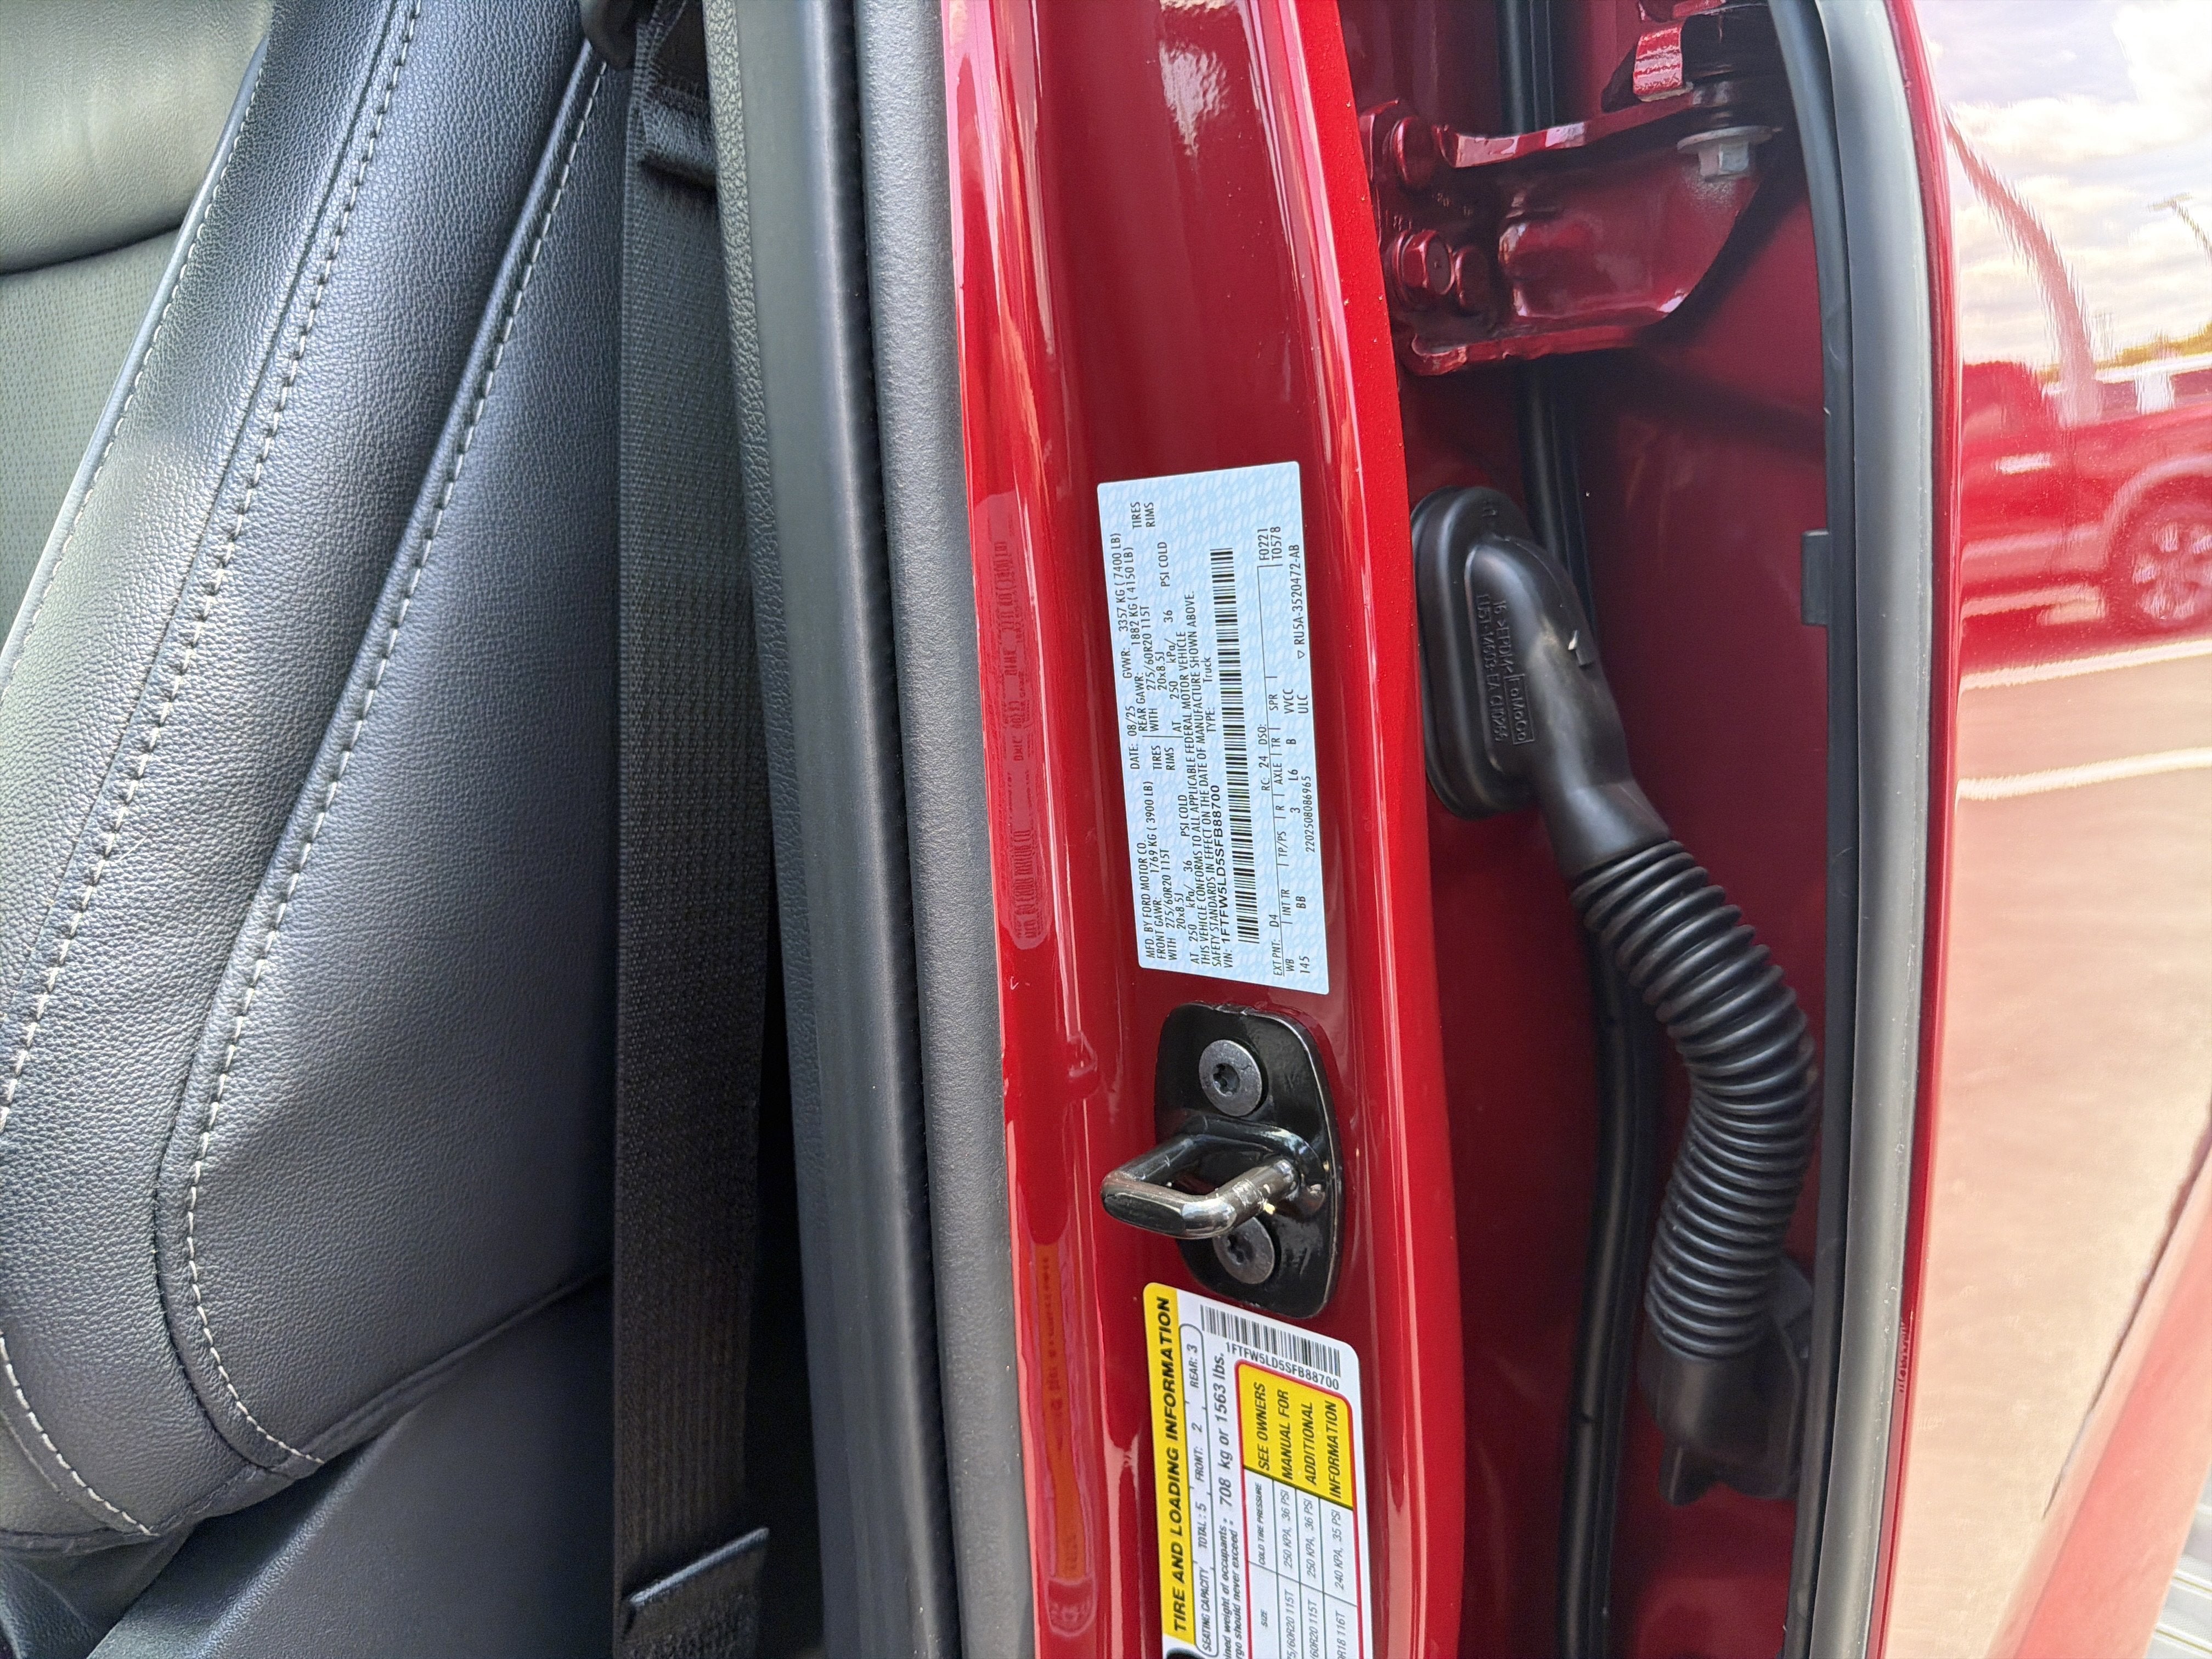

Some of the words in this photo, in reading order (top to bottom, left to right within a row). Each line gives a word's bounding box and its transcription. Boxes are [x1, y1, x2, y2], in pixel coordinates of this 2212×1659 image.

[1130, 501, 1142, 530] TIRES
[1143, 502, 1156, 528] RIMS
[1109, 533, 1121, 549] LB)
[1257, 528, 1270, 561] F0221
[1269, 526, 1283, 561] T0578
[1111, 552, 1124, 579] 7400
[1122, 547, 1134, 563] LB)
[1157, 541, 1169, 568] COLD
[1124, 567, 1136, 593] 4150
[1159, 572, 1171, 587] PSI
[1115, 589, 1126, 603] KG
[1288, 544, 1305, 645] RU5A-3520472-AB
[1116, 607, 1128, 632] 3357
[1127, 603, 1138, 617] KG
[1139, 605, 1151, 629] 115T
[1163, 610, 1173, 623] 36
[1184, 591, 1197, 628] ABOVE.
[1129, 620, 1141, 646] 1882
[1142, 633, 1156, 691] 275/60R20
[1163, 638, 1177, 663] kPa/
[1175, 631, 1188, 672] VEHICLE
[1187, 631, 1201, 669] SHOWN
[1120, 647, 1132, 679] GVWR:
[1154, 651, 1167, 691] 20x8.5J
[1200, 657, 1213, 684] Truck
[1134, 672, 1146, 704] GAWR:
[1168, 681, 1180, 699] 250
[1179, 674, 1192, 710] MOTOR
[1190, 672, 1205, 744] MANUFACTURE
[1268, 693, 1279, 711] SPR
[1282, 689, 1295, 714] VVCC
[1296, 694, 1309, 714] ULC
[1508, 677, 1528, 742] FoMoCo
[1125, 706, 1139, 737] 08/25
[1136, 707, 1148, 731] REAR
[1148, 708, 1159, 732] WITH
[1171, 720, 1182, 733] AT
[1205, 707, 1217, 733] TYPE:
[1182, 713, 1195, 754] FEDERAL
[1257, 724, 1269, 747] DSO:
[1271, 737, 1281, 748] TR
[1128, 743, 1140, 770] DATE:
[1150, 745, 1163, 771] TIRES
[1164, 747, 1176, 771] RIMS
[1195, 747, 1207, 760] OF
[1258, 755, 1271, 769] 24
[1185, 757, 1200, 814] APPLICABLE
[1197, 763, 1209, 787] DATE
[1260, 777, 1272, 791] RC:
[1272, 763, 1283, 785] AXLE
[1287, 769, 1299, 781] L6
[1142, 781, 1154, 796] LB)
[1199, 789, 1210, 808] THE
[1144, 799, 1155, 823] 3900
[1177, 794, 1189, 819] COLD
[1201, 811, 1211, 825] ON
[1301, 776, 1316, 853] 2202508086965
[1180, 822, 1190, 837] PSI
[1190, 816, 1201, 833] ALL
[1136, 840, 1147, 855] CO.
[1147, 833, 1158, 847] KG
[1192, 835, 1202, 848] TO
[1202, 828, 1214, 860] EFFECT
[1276, 831, 1288, 857] TP/PS
[1148, 850, 1160, 873] 1769
[1159, 848, 1171, 871] 115T
[1182, 860, 1193, 872] 36
[1205, 863, 1215, 873] IN
[1210, 785, 1231, 944] 1FTFW5LD5SFB88700
[1138, 857, 1150, 891] MOTOR
[1192, 850, 1206, 902] CONFORMS
[1141, 893, 1153, 918] FORD
[1161, 874, 1177, 929] 275/60R20
[1183, 884, 1196, 909] kPa/
[1205, 876, 1220, 932] STANDARDS
[1280, 889, 1290, 899] TR
[1295, 896, 1306, 909] BB
[1152, 897, 1164, 927] GAWR:
[1173, 893, 1186, 930] 20x8.5J
[1268, 914, 1281, 928] D4
[1281, 901, 1291, 916] INT
[1143, 920, 1154, 933] BY
[1187, 924, 1199, 943] 250
[1197, 905, 1209, 942] VEHICLE
[1144, 936, 1156, 958] MFD.
[1154, 929, 1166, 960] FRONT
[1166, 937, 1178, 961] WITH
[1199, 945, 1211, 965] THIS
[1210, 934, 1222, 967] SAFETY
[1271, 939, 1282, 958] PNT:
[1189, 952, 1200, 964] AT
[1222, 949, 1233, 968] VIN:
[1272, 960, 1283, 976] EXT
[1285, 958, 1295, 972] WB
[1299, 955, 1311, 974] 145
[1186, 1343, 1198, 1355] 3
[1156, 1296, 1178, 1441] INFORMATION
[1188, 1357, 1200, 1389] REAR:
[1211, 1352, 1226, 1381] lbs.
[1226, 1341, 1339, 1391] 1FTFW5LD5SFB88700
[1212, 1383, 1228, 1423] 1563
[1253, 1381, 1268, 1442] OWNERS
[1277, 1389, 1290, 1419] FOR
[1190, 1421, 1203, 1434] 2
[1218, 1427, 1229, 1446] or
[1278, 1422, 1294, 1481] MANUAL
[1300, 1402, 1317, 1487] ADDITIONAL
[1324, 1400, 1342, 1499] INFORMATION
[1193, 1446, 1205, 1483] FRONT:
[1217, 1449, 1233, 1470] kg
[1257, 1443, 1270, 1472] SEE
[1165, 1446, 1183, 1537] LOADING
[1218, 1476, 1233, 1508] 708
[1254, 1481, 1264, 1525] PRESSURE
[1279, 1488, 1290, 1506] PSI
[1194, 1500, 1207, 1513] 5
[1280, 1506, 1291, 1522] 36
[1303, 1498, 1314, 1516] PSI
[1330, 1509, 1342, 1527] PSI
[1256, 1523, 1265, 1543] TIRE
[1304, 1516, 1315, 1532] 36
[1331, 1526, 1342, 1543] 35
[1228, 1528, 1240, 1570] exceed
[1282, 1527, 1293, 1549] KPA,
[1305, 1536, 1316, 1559] KPA,
[1170, 1541, 1186, 1584] AND
[1218, 1524, 1230, 1583] occupants
[1257, 1543, 1266, 1566] COLD
[1282, 1549, 1293, 1570] 250
[1333, 1547, 1345, 1570] KPA,
[1306, 1558, 1317, 1580] 250
[1333, 1570, 1345, 1592] 240
[1199, 1566, 1211, 1613] CAPACITY
[1220, 1582, 1230, 1596] of
[1232, 1569, 1241, 1602] never
[1172, 1586, 1187, 1632] TIRE
[1284, 1588, 1295, 1615] 115T
[1307, 1598, 1318, 1625] 115T
[1221, 1596, 1235, 1634] weight
[1231, 1602, 1243, 1641] should
[1260, 1609, 1268, 1629] SIZE
[1335, 1609, 1346, 1637] 116T
[1200, 1612, 1212, 1652] SEATING
